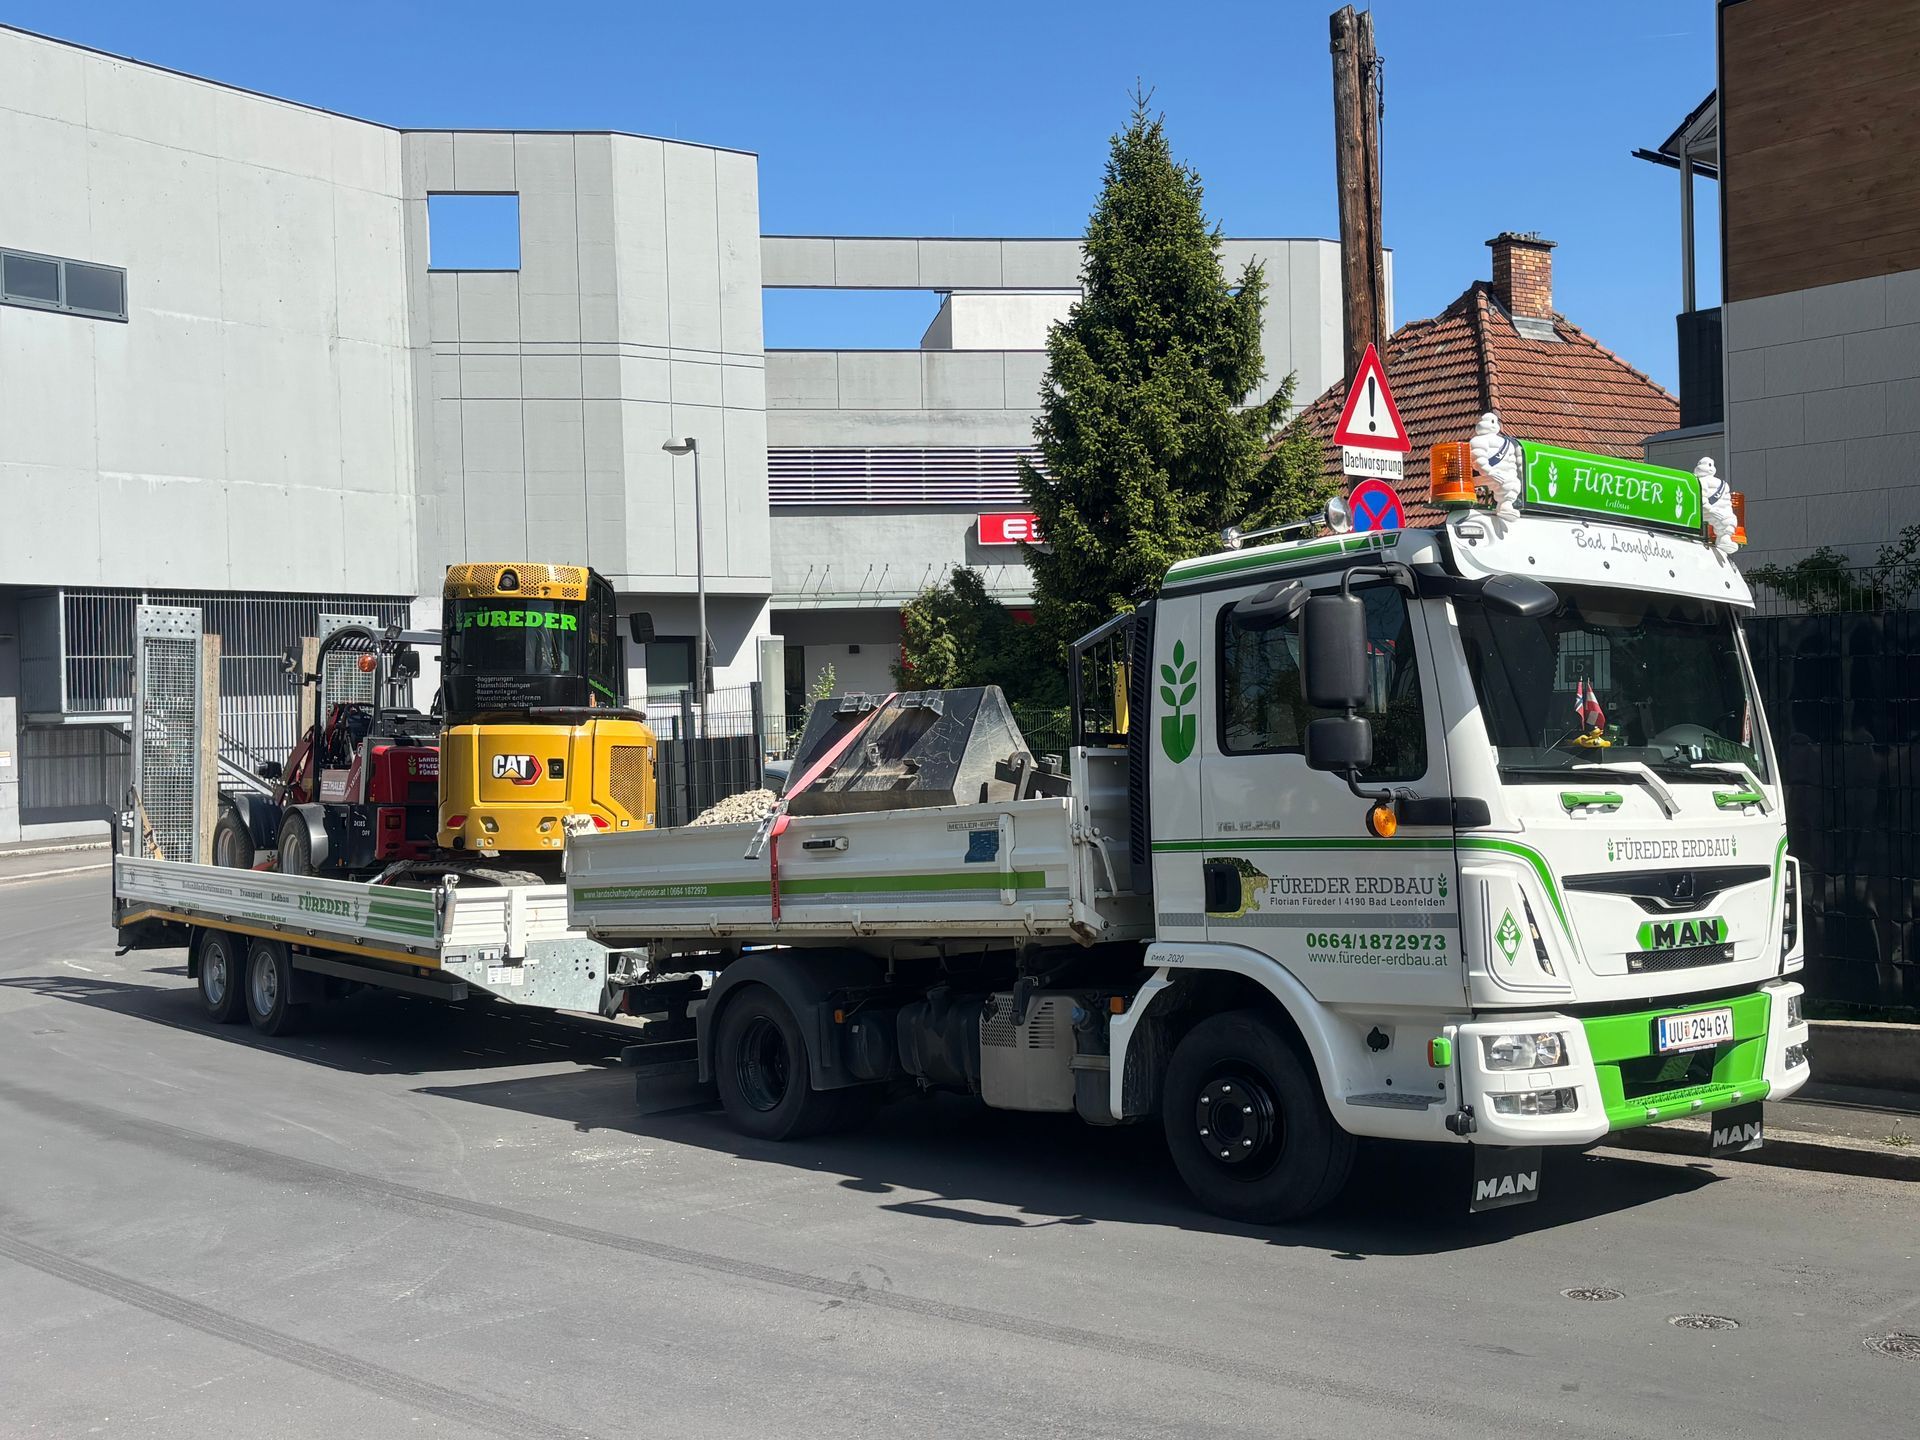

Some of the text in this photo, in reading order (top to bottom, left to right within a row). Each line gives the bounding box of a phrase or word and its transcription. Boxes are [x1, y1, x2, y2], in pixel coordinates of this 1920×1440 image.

[1344, 451, 1402, 475] Dachvorsprung
[1573, 467, 1664, 504] FÜREDER
[1003, 518, 1040, 539] E
[1571, 528, 1675, 562] Bad Leonfelden
[463, 606, 577, 632] FÜREDER
[493, 755, 530, 779] CAT
[1615, 837, 1730, 861] FÜREDER ERDBAU
[1269, 875, 1435, 894] FÜREDER ERDBAU
[298, 891, 351, 917] FÜREDER
[1270, 897, 1300, 906] Florian
[1302, 897, 1336, 906] Füreder
[1344, 898, 1366, 906] 4190
[1369, 898, 1387, 906] Bad
[1390, 898, 1445, 907] Leonfelden
[1306, 933, 1447, 950] 0664/1872973
[1652, 919, 1720, 948] MAN
[1167, 953, 1185, 963] 2020
[1308, 951, 1448, 966] www.füreder-erdbau.at
[1669, 1014, 1729, 1043] UU 294 GX
[1713, 1121, 1760, 1148] MAN
[1475, 1170, 1538, 1201] MAN
